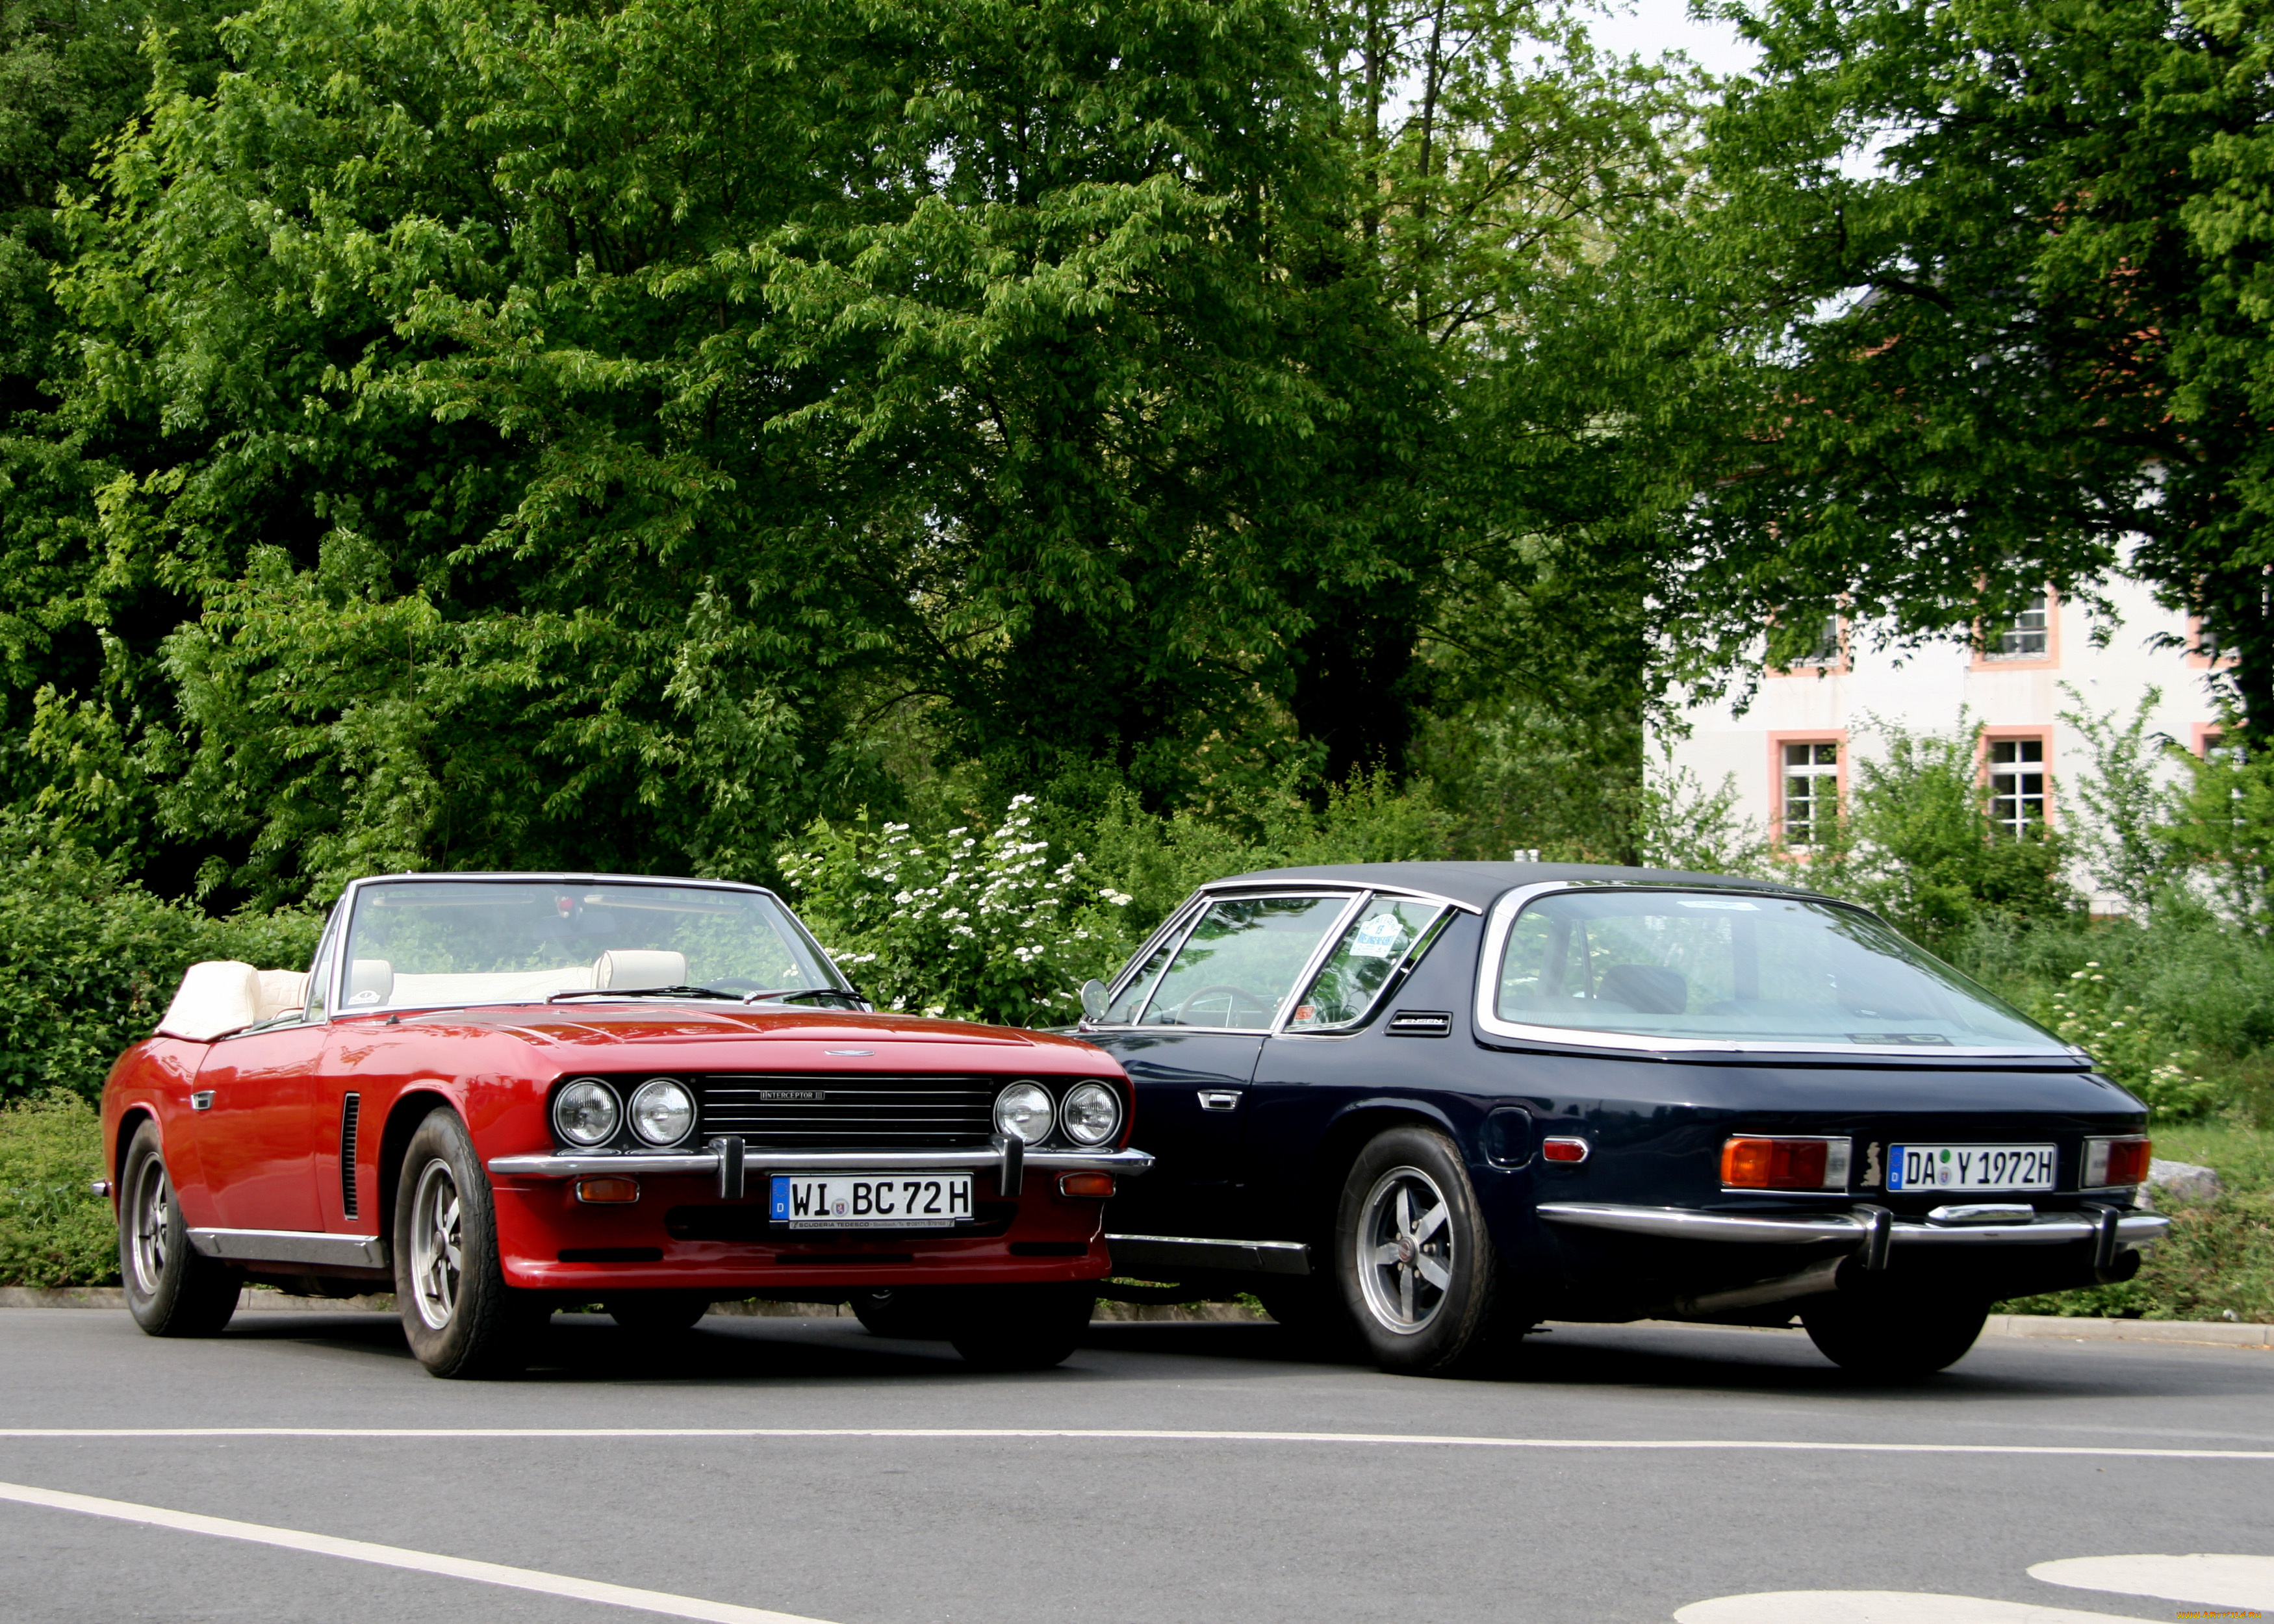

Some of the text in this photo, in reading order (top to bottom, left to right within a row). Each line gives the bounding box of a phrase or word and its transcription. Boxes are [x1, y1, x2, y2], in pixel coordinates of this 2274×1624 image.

[1906, 1151, 1935, 1184] DA
[1957, 1151, 1971, 1184] Y
[776, 1202, 784, 1213] D
[792, 1183, 830, 1216] WI
